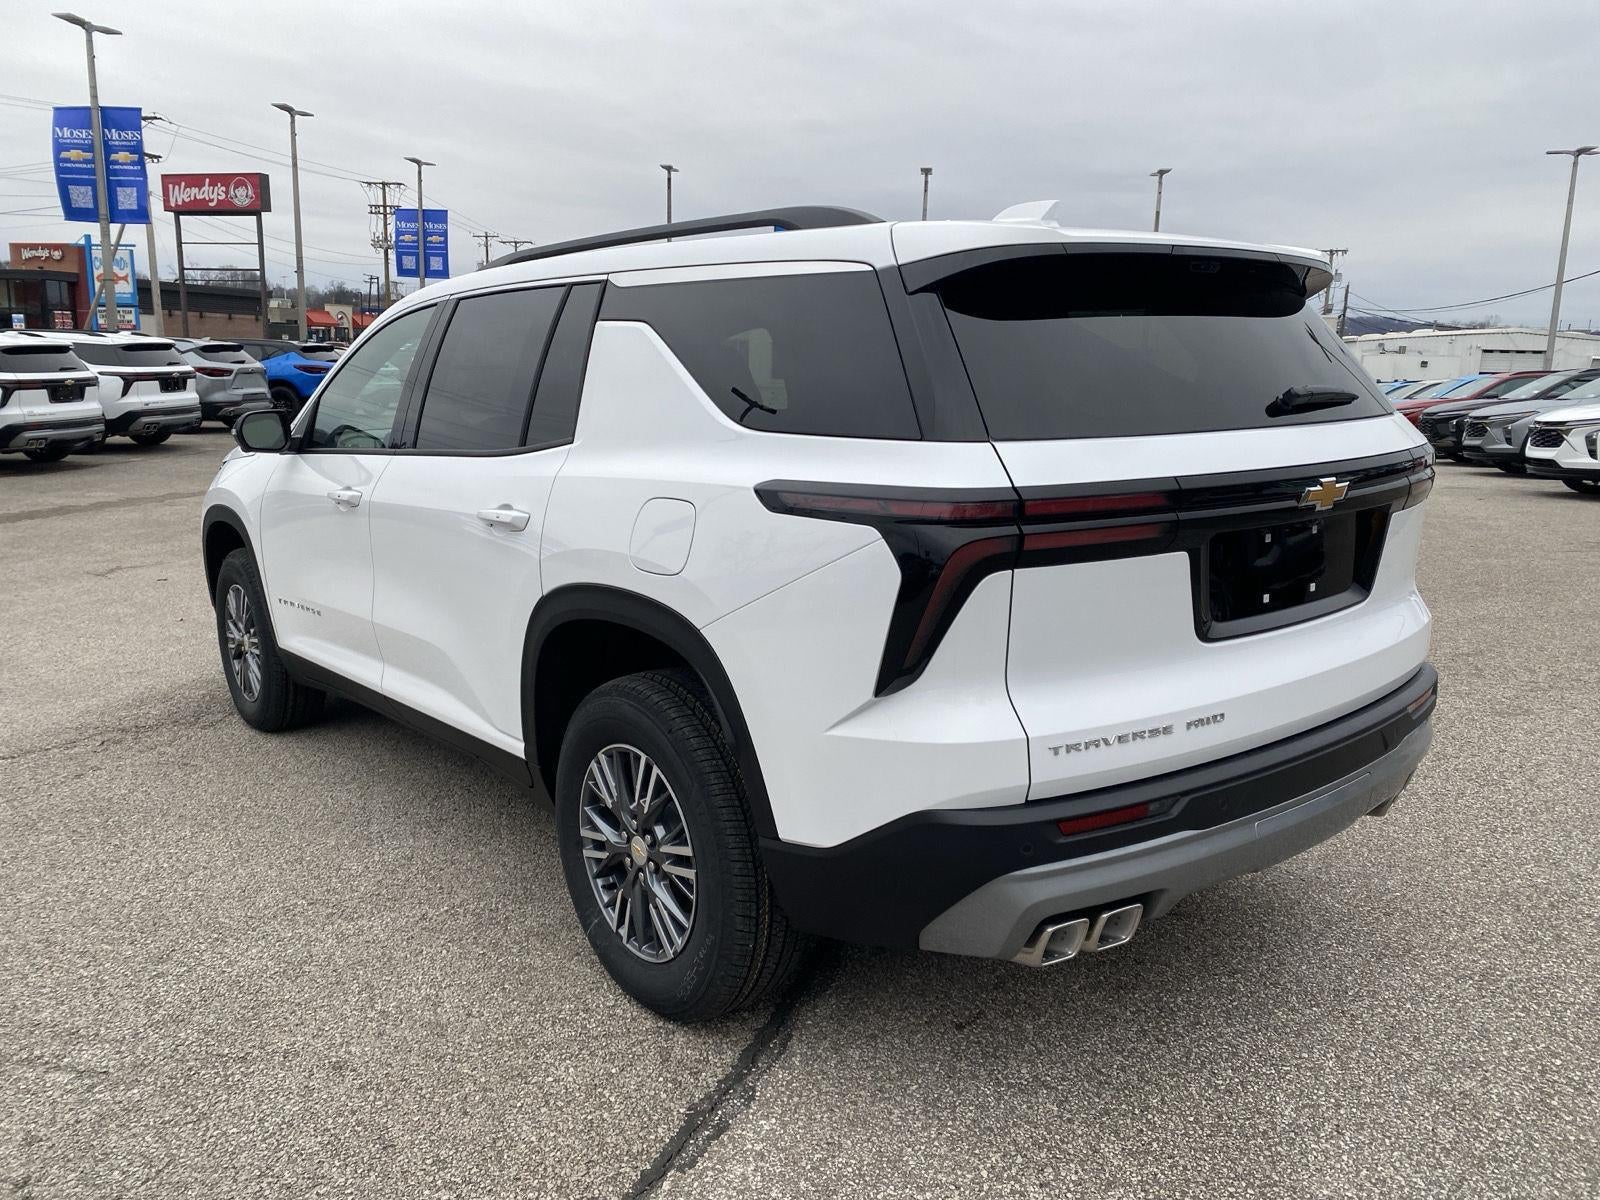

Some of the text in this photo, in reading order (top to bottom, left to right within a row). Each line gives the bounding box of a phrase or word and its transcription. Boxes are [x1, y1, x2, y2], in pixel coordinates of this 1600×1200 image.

[104, 128, 141, 140] MOSES
[168, 178, 226, 207] Wendy's
[21, 246, 50, 260] Wendy's
[1048, 724, 1174, 757] TRAVERSE
